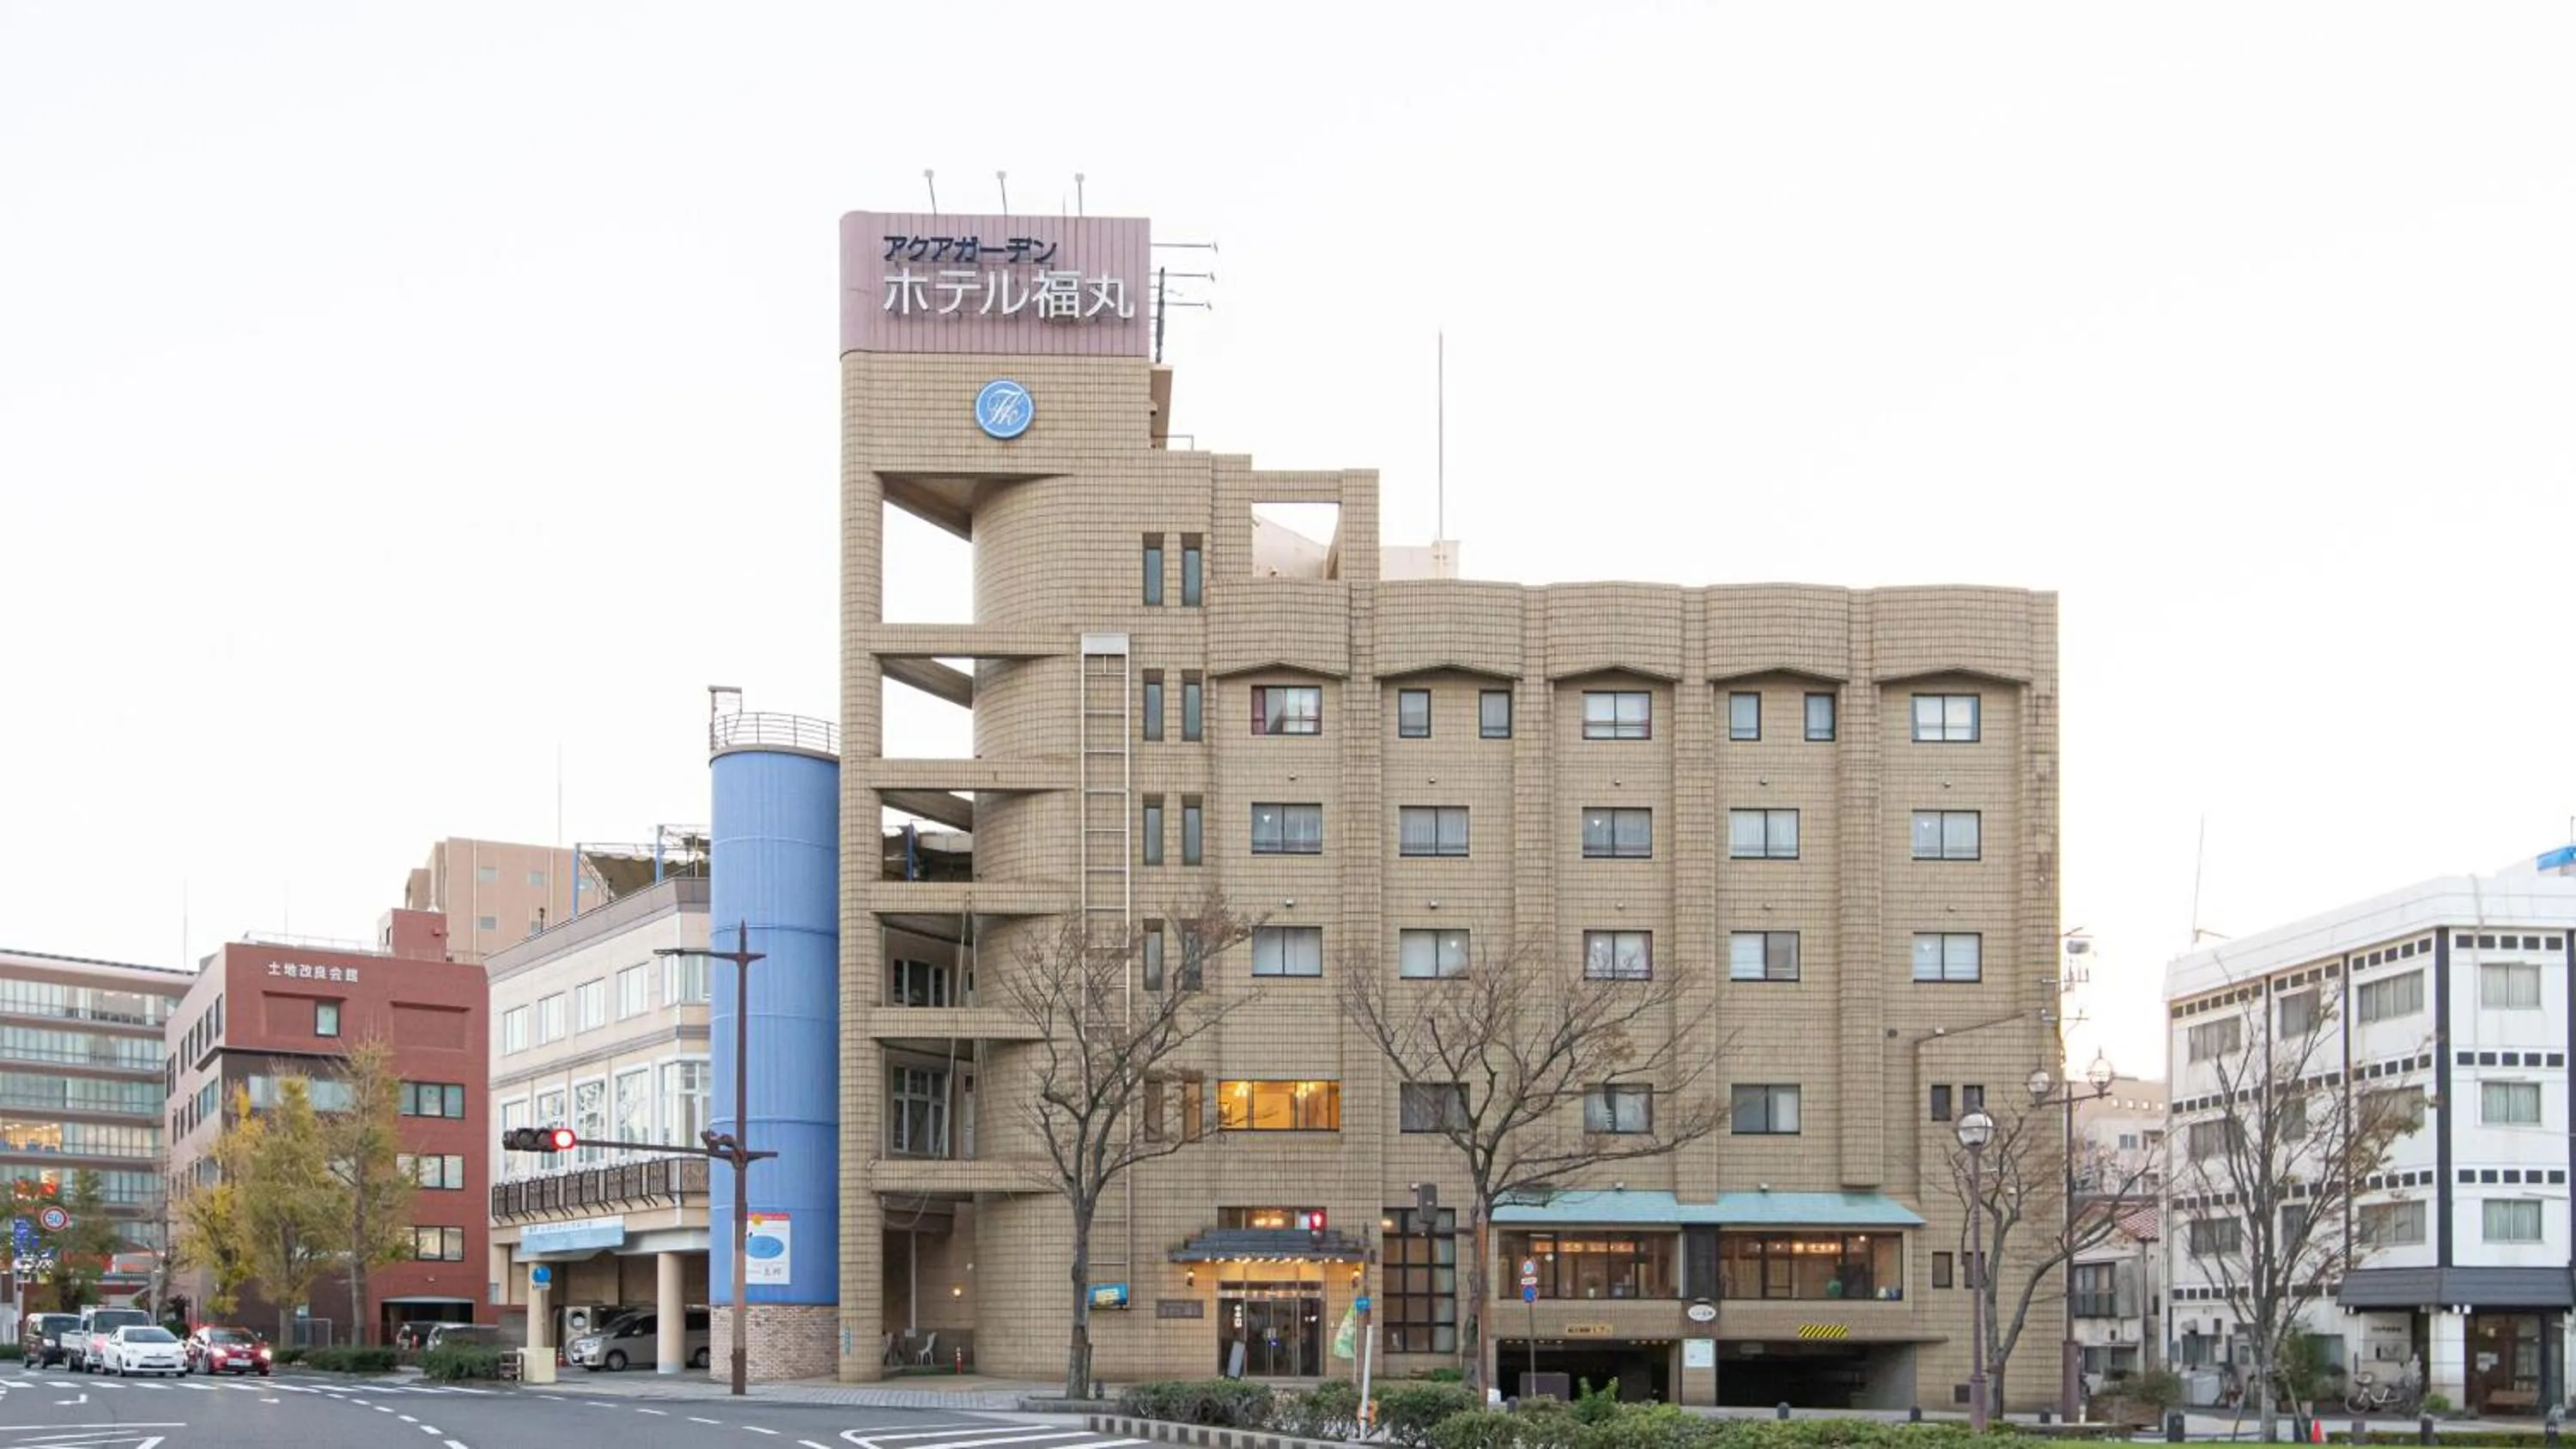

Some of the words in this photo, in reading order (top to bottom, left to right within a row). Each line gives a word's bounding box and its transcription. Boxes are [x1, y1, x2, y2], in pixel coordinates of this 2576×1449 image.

[883, 235, 1057, 263] アクアガーデン
[883, 267, 1134, 318] ホテル福丸
[268, 961, 358, 983] 土地改良会館
[47, 1213, 62, 1224] 50
